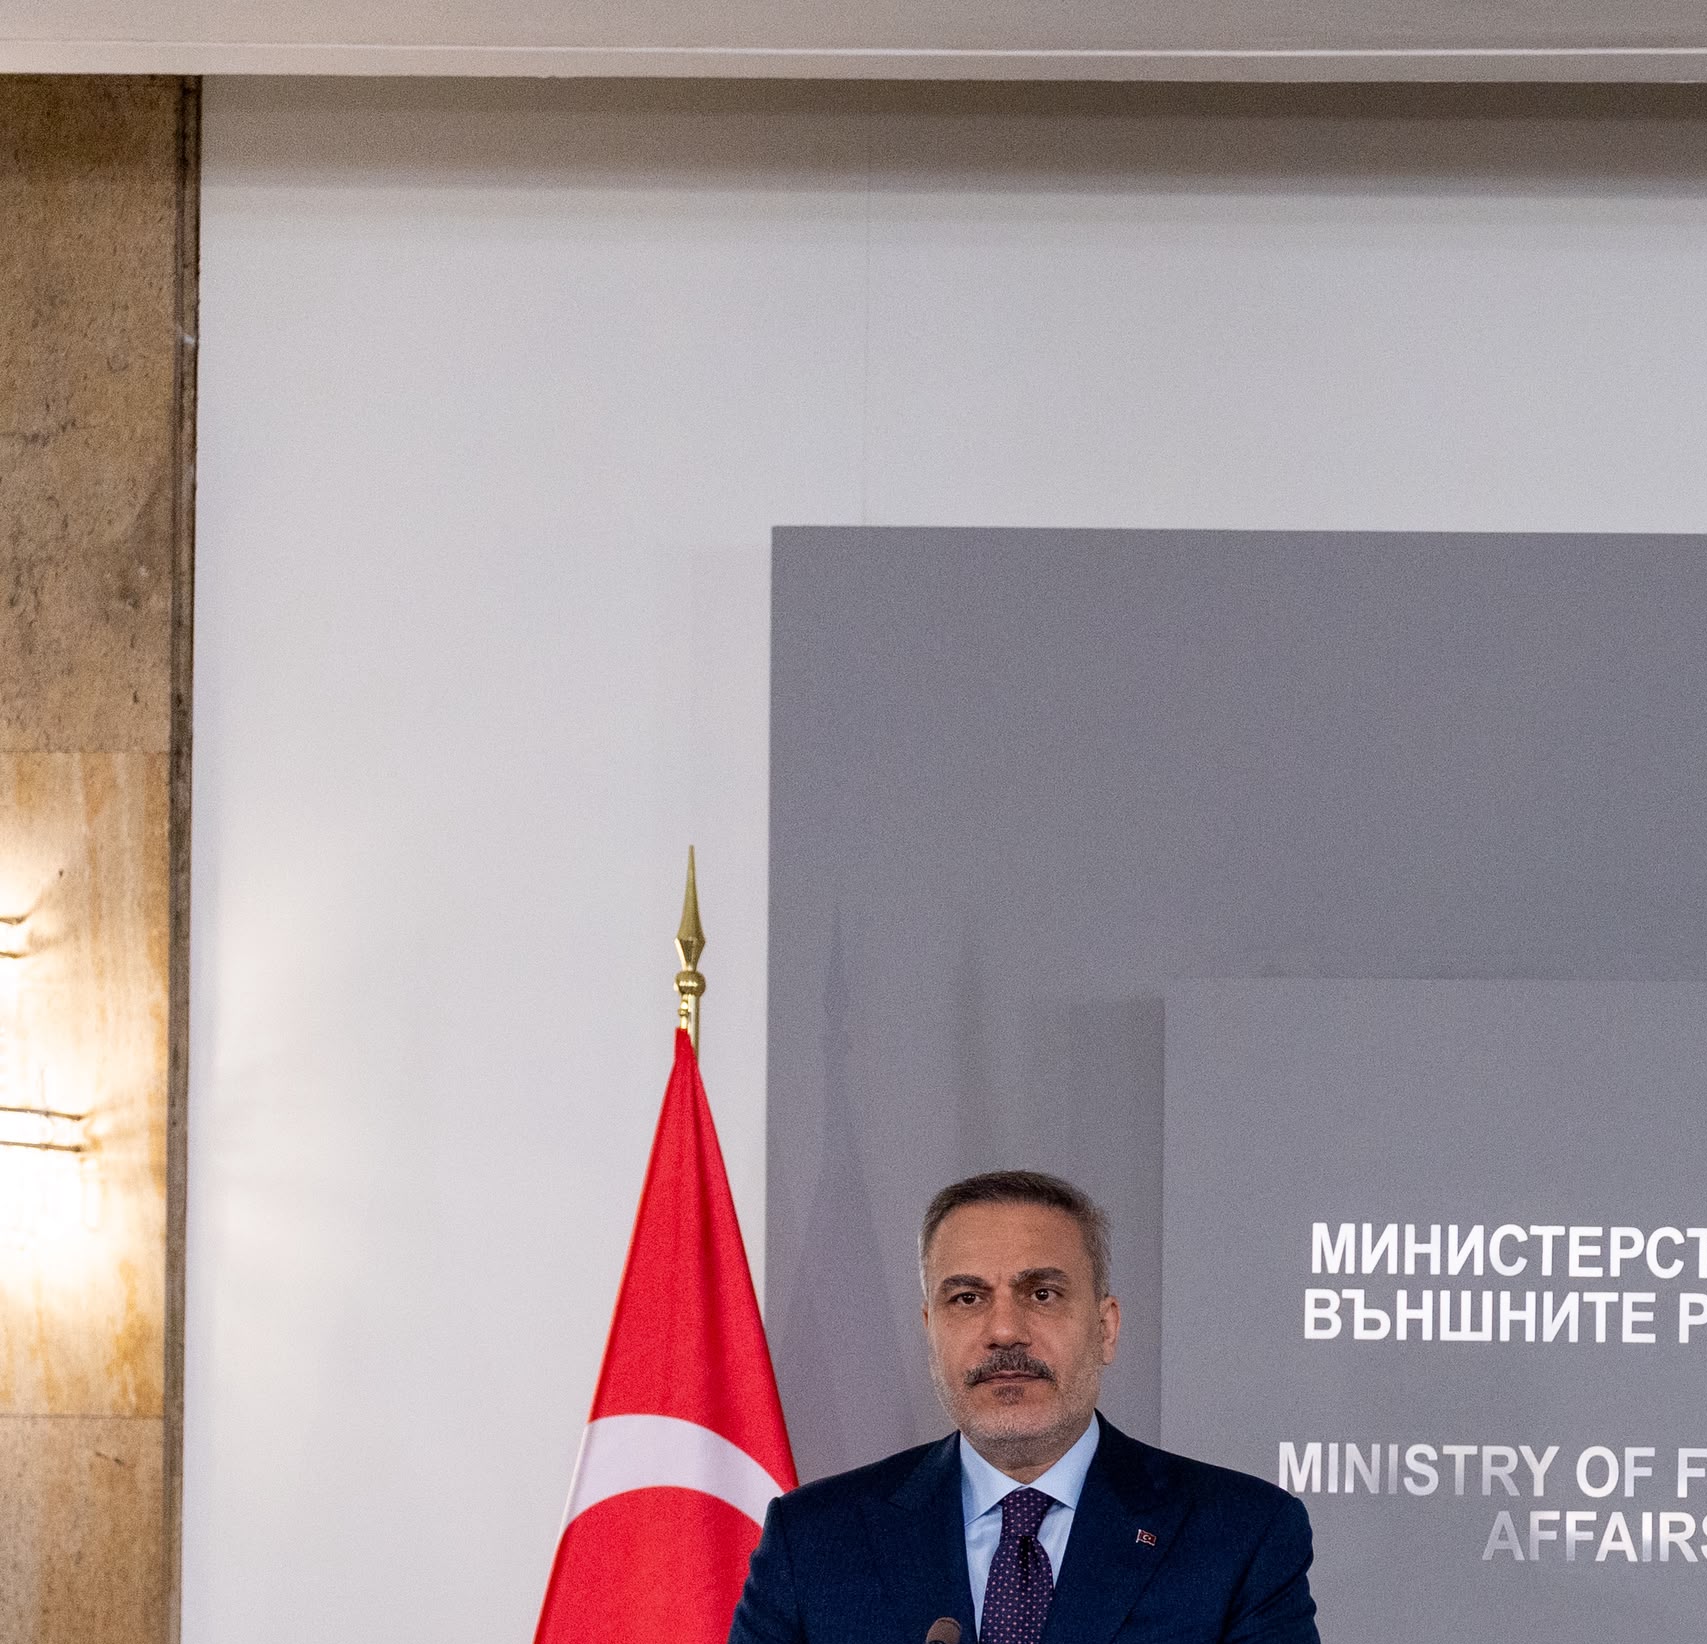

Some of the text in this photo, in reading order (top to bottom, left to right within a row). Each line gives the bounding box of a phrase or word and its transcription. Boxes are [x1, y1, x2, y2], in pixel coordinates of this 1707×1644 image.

[1303, 1288, 1657, 1345] ВЪНШНИТЕ
[1277, 1440, 1561, 1498] MINISTRY
[1574, 1444, 1656, 1499] OF
